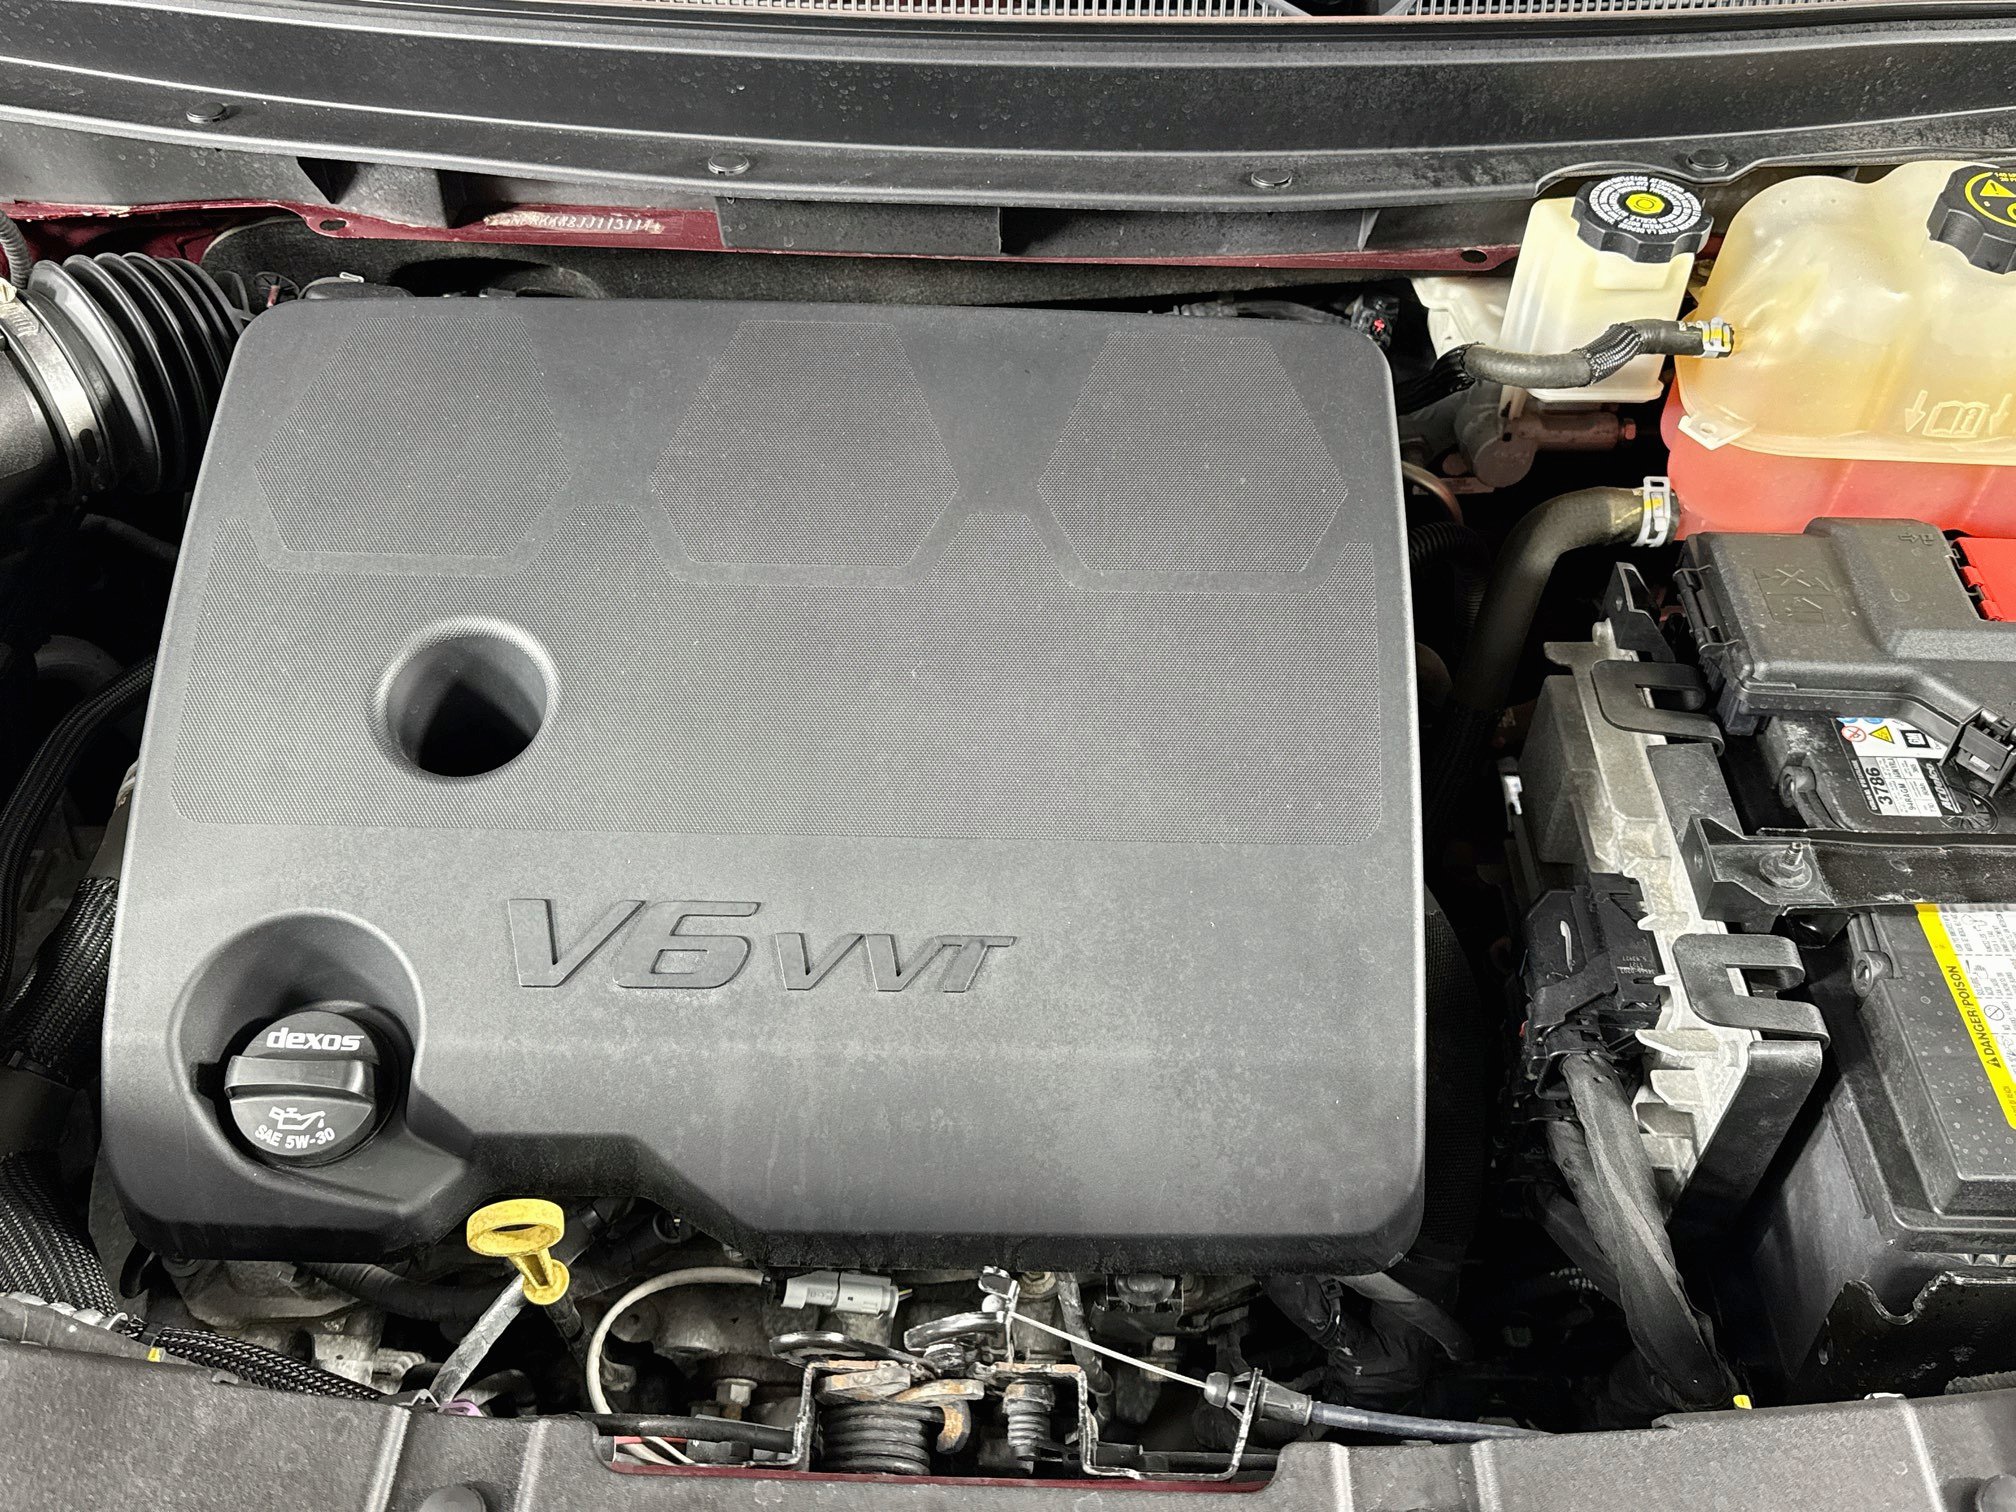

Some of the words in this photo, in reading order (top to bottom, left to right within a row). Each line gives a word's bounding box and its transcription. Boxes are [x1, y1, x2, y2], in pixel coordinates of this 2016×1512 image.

[1865, 767, 1893, 805] 3786
[507, 898, 761, 990] V6
[774, 932, 1018, 993] VVT
[1945, 965, 1996, 1056] DANGER/POISON
[265, 1027, 365, 1051] dexos
[254, 1124, 283, 1147] SAE
[284, 1127, 336, 1149] 5W-30
